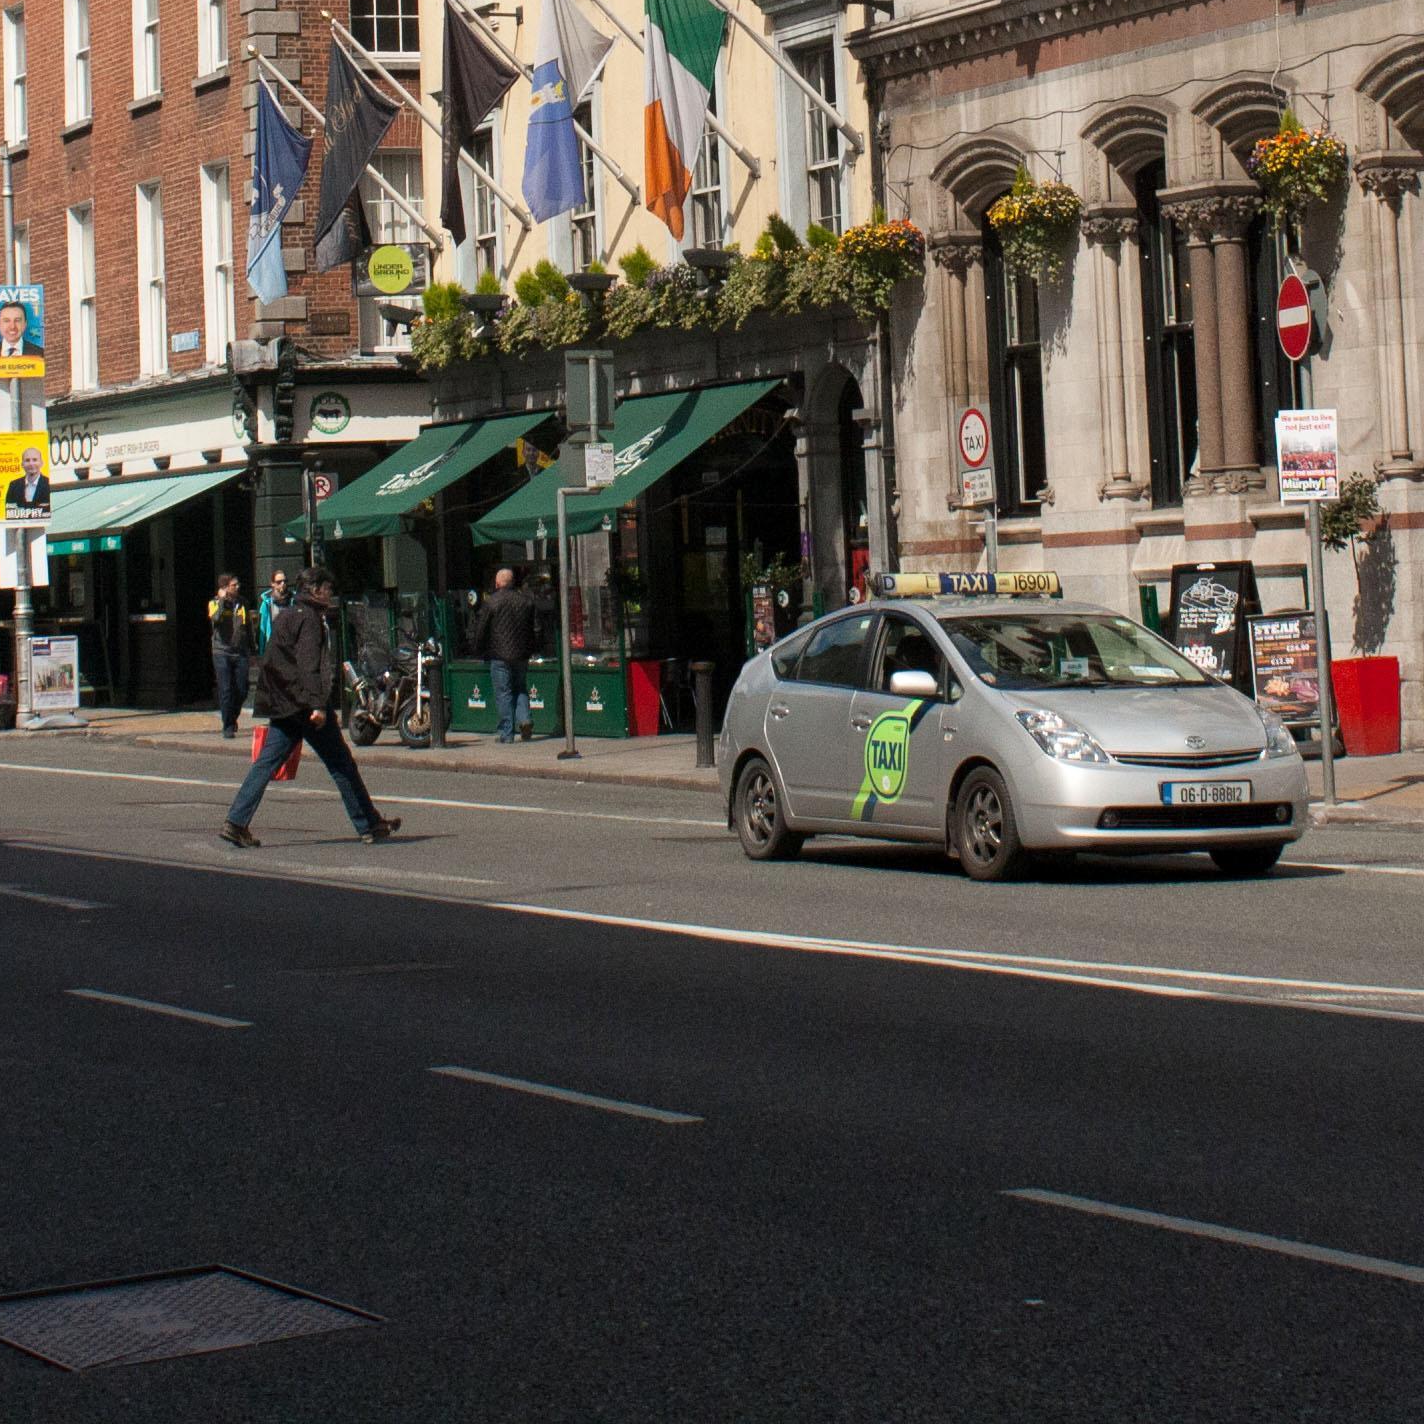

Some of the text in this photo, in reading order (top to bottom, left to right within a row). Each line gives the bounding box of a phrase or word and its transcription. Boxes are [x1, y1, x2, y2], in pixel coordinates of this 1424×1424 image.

[1298, 424, 1312, 432] just
[964, 436, 984, 451] TAXI
[1282, 477, 1320, 491] Murphy
[6, 508, 44, 519] MURPHY
[883, 574, 1050, 592] D TAXI 16901
[1253, 619, 1301, 636] STEAK
[871, 740, 902, 771] TAXI
